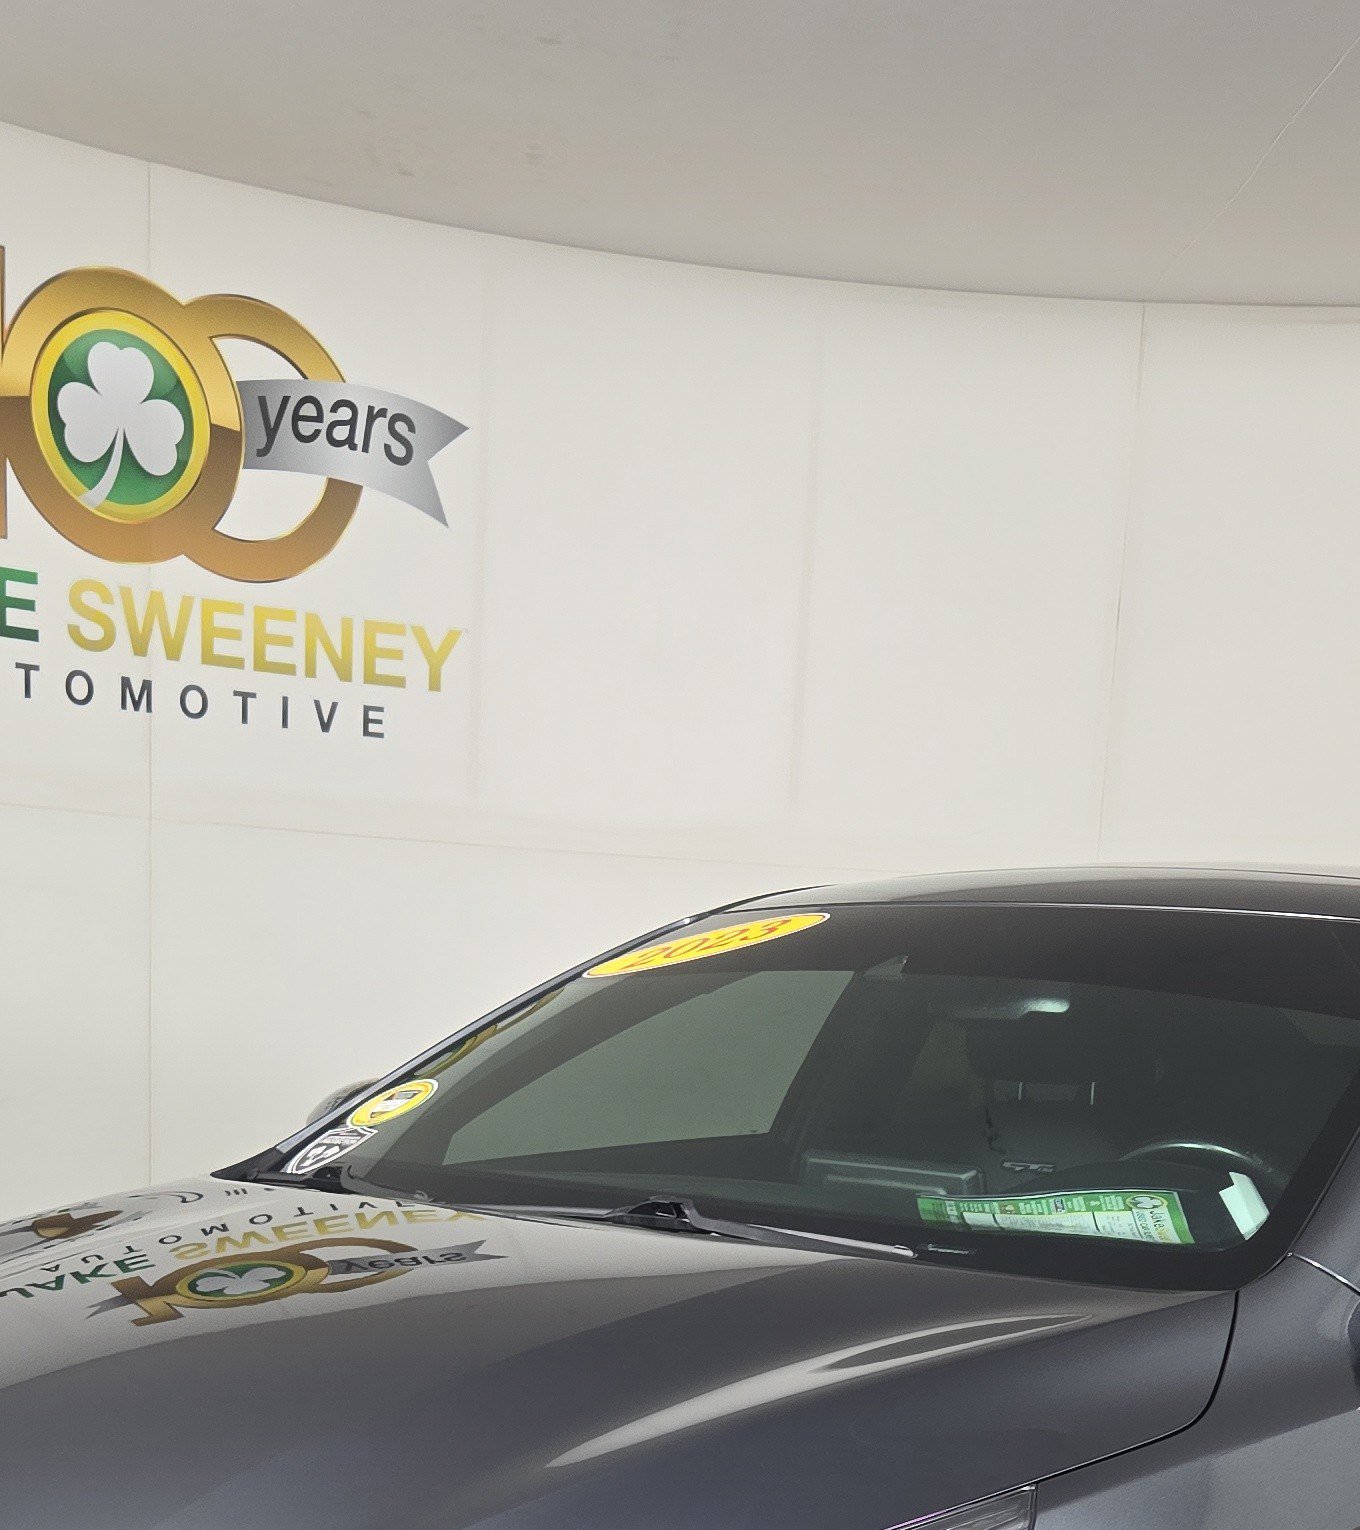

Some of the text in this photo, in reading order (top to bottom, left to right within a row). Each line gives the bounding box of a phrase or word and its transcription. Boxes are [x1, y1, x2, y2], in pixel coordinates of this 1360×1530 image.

[255, 394, 417, 466] years
[67, 579, 463, 692] SWEENEY
[619, 918, 792, 971] 2023
